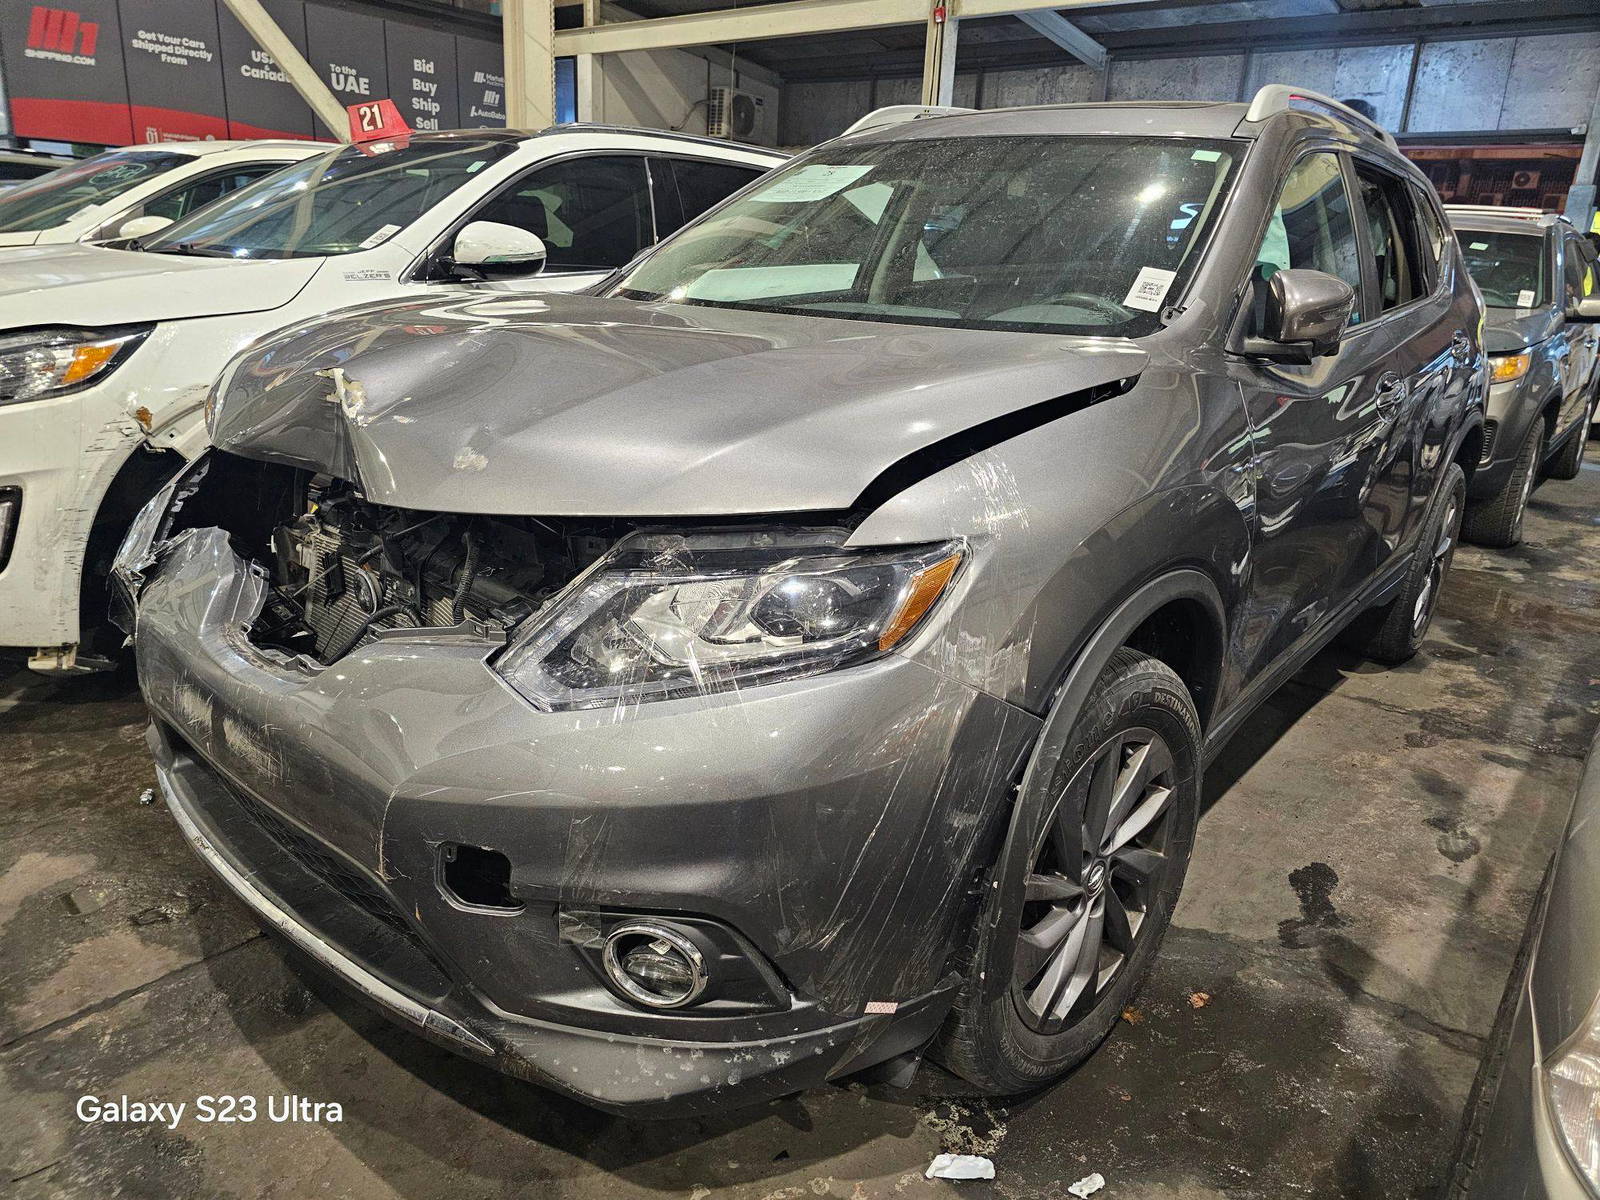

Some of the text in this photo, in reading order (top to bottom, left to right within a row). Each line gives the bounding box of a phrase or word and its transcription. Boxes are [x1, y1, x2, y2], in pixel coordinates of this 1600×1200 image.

[138, 30, 205, 49] Get Your Cars
[132, 39, 212, 62] Shipped Directly
[161, 54, 188, 65] From
[330, 63, 357, 76] To the
[413, 59, 434, 74] Bid
[330, 73, 370, 95] UAE
[412, 78, 437, 96] Buy
[412, 98, 440, 116] Ship
[359, 104, 383, 131] 21
[416, 117, 438, 130] Sell
